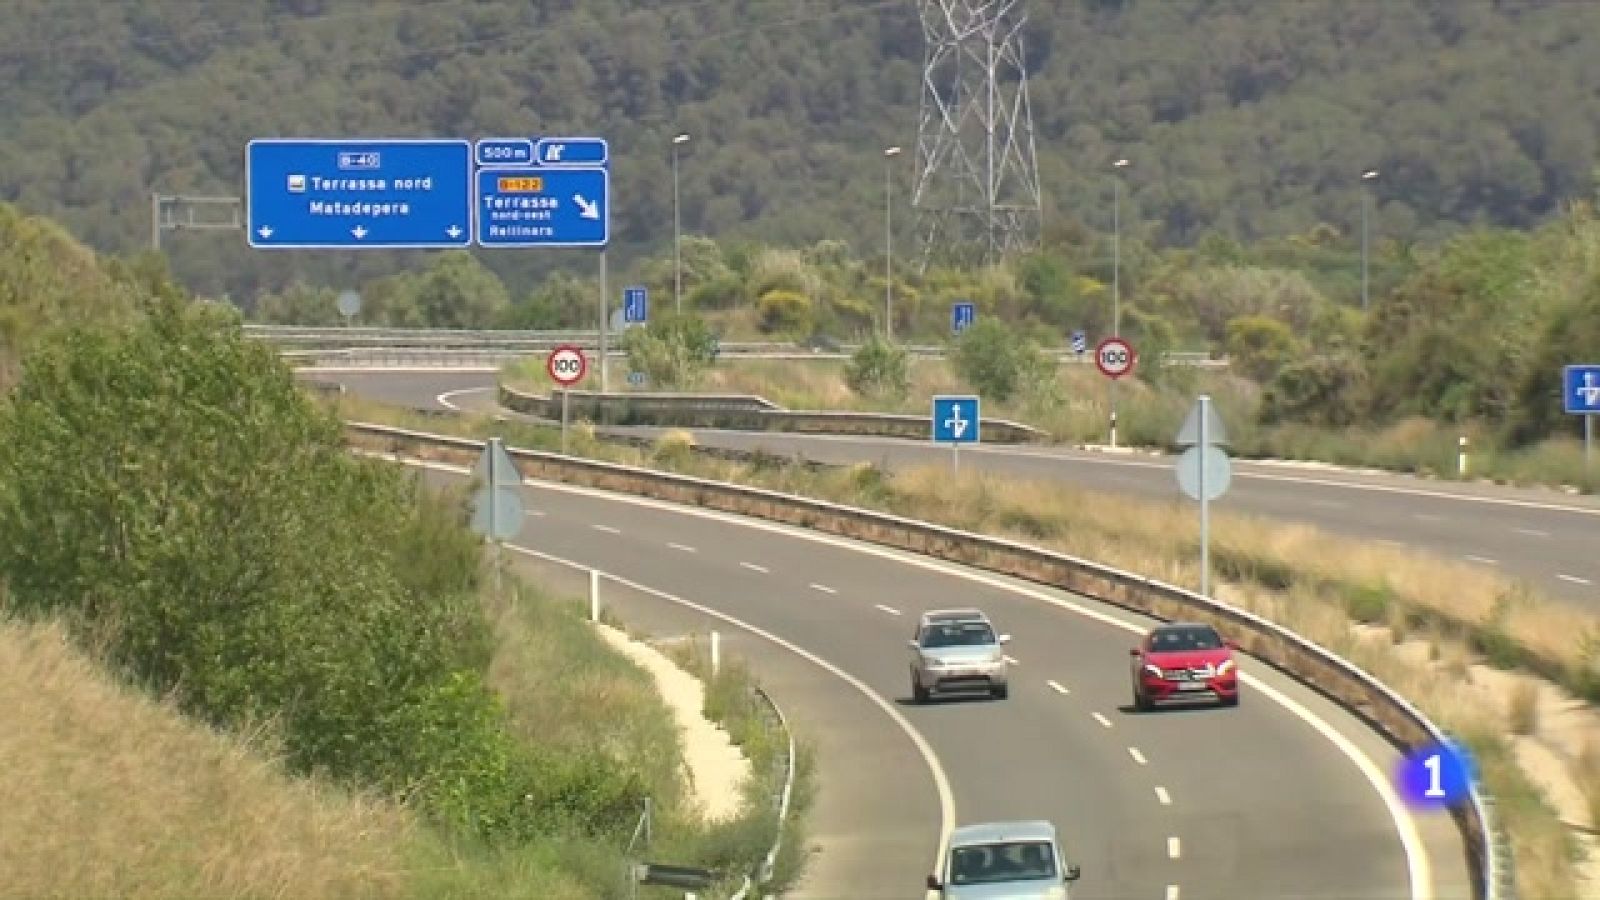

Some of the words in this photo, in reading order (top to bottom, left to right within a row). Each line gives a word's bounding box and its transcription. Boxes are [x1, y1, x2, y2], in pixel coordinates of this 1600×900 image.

[484, 146, 512, 159] 500
[514, 149, 526, 159] m
[311, 176, 386, 191] Terrassa
[394, 176, 432, 191] nord
[309, 200, 410, 217] Matadepera
[484, 194, 559, 209] Terrassa
[1101, 350, 1127, 365] 100
[554, 358, 579, 373] 100
